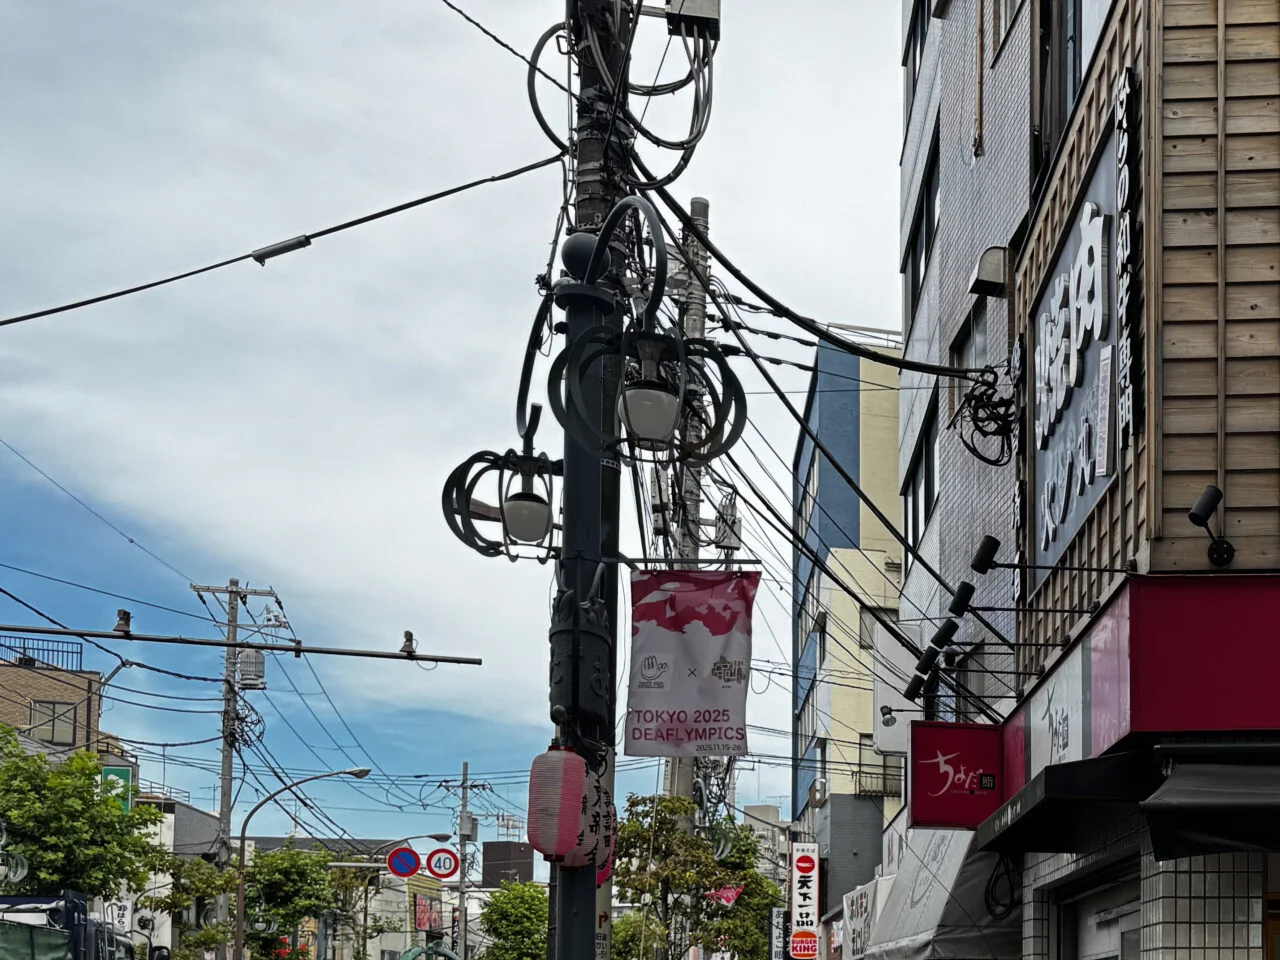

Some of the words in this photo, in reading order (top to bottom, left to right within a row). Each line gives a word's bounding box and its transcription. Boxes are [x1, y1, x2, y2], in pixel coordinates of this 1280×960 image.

[634, 710, 688, 724] TOKYO
[693, 709, 730, 723] 2025
[631, 727, 745, 741] DEAFLYMPICS
[434, 857, 452, 871] 40
[796, 875, 814, 927] 天下一品
[791, 945, 817, 953] KING
